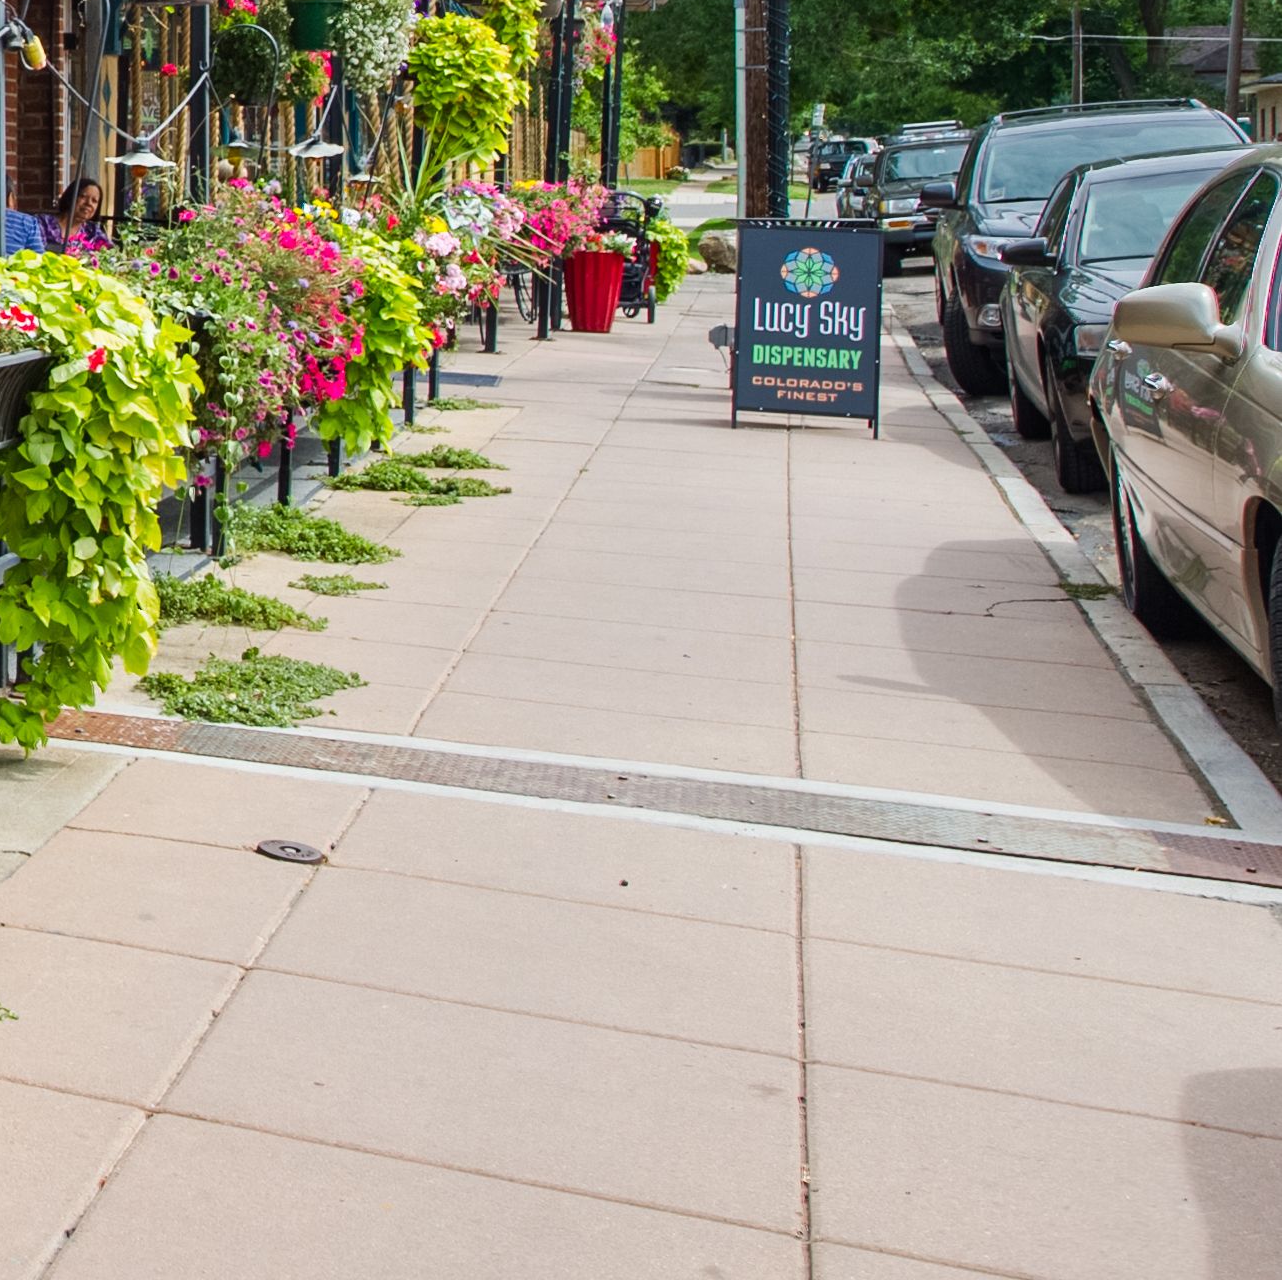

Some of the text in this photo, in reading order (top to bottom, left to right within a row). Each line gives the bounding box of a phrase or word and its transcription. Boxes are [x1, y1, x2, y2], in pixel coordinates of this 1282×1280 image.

[753, 297, 866, 341] Lucy Sky
[752, 344, 862, 370] DISPENSARY
[752, 376, 864, 392] COLORADO'S
[776, 391, 838, 402] FINEST
